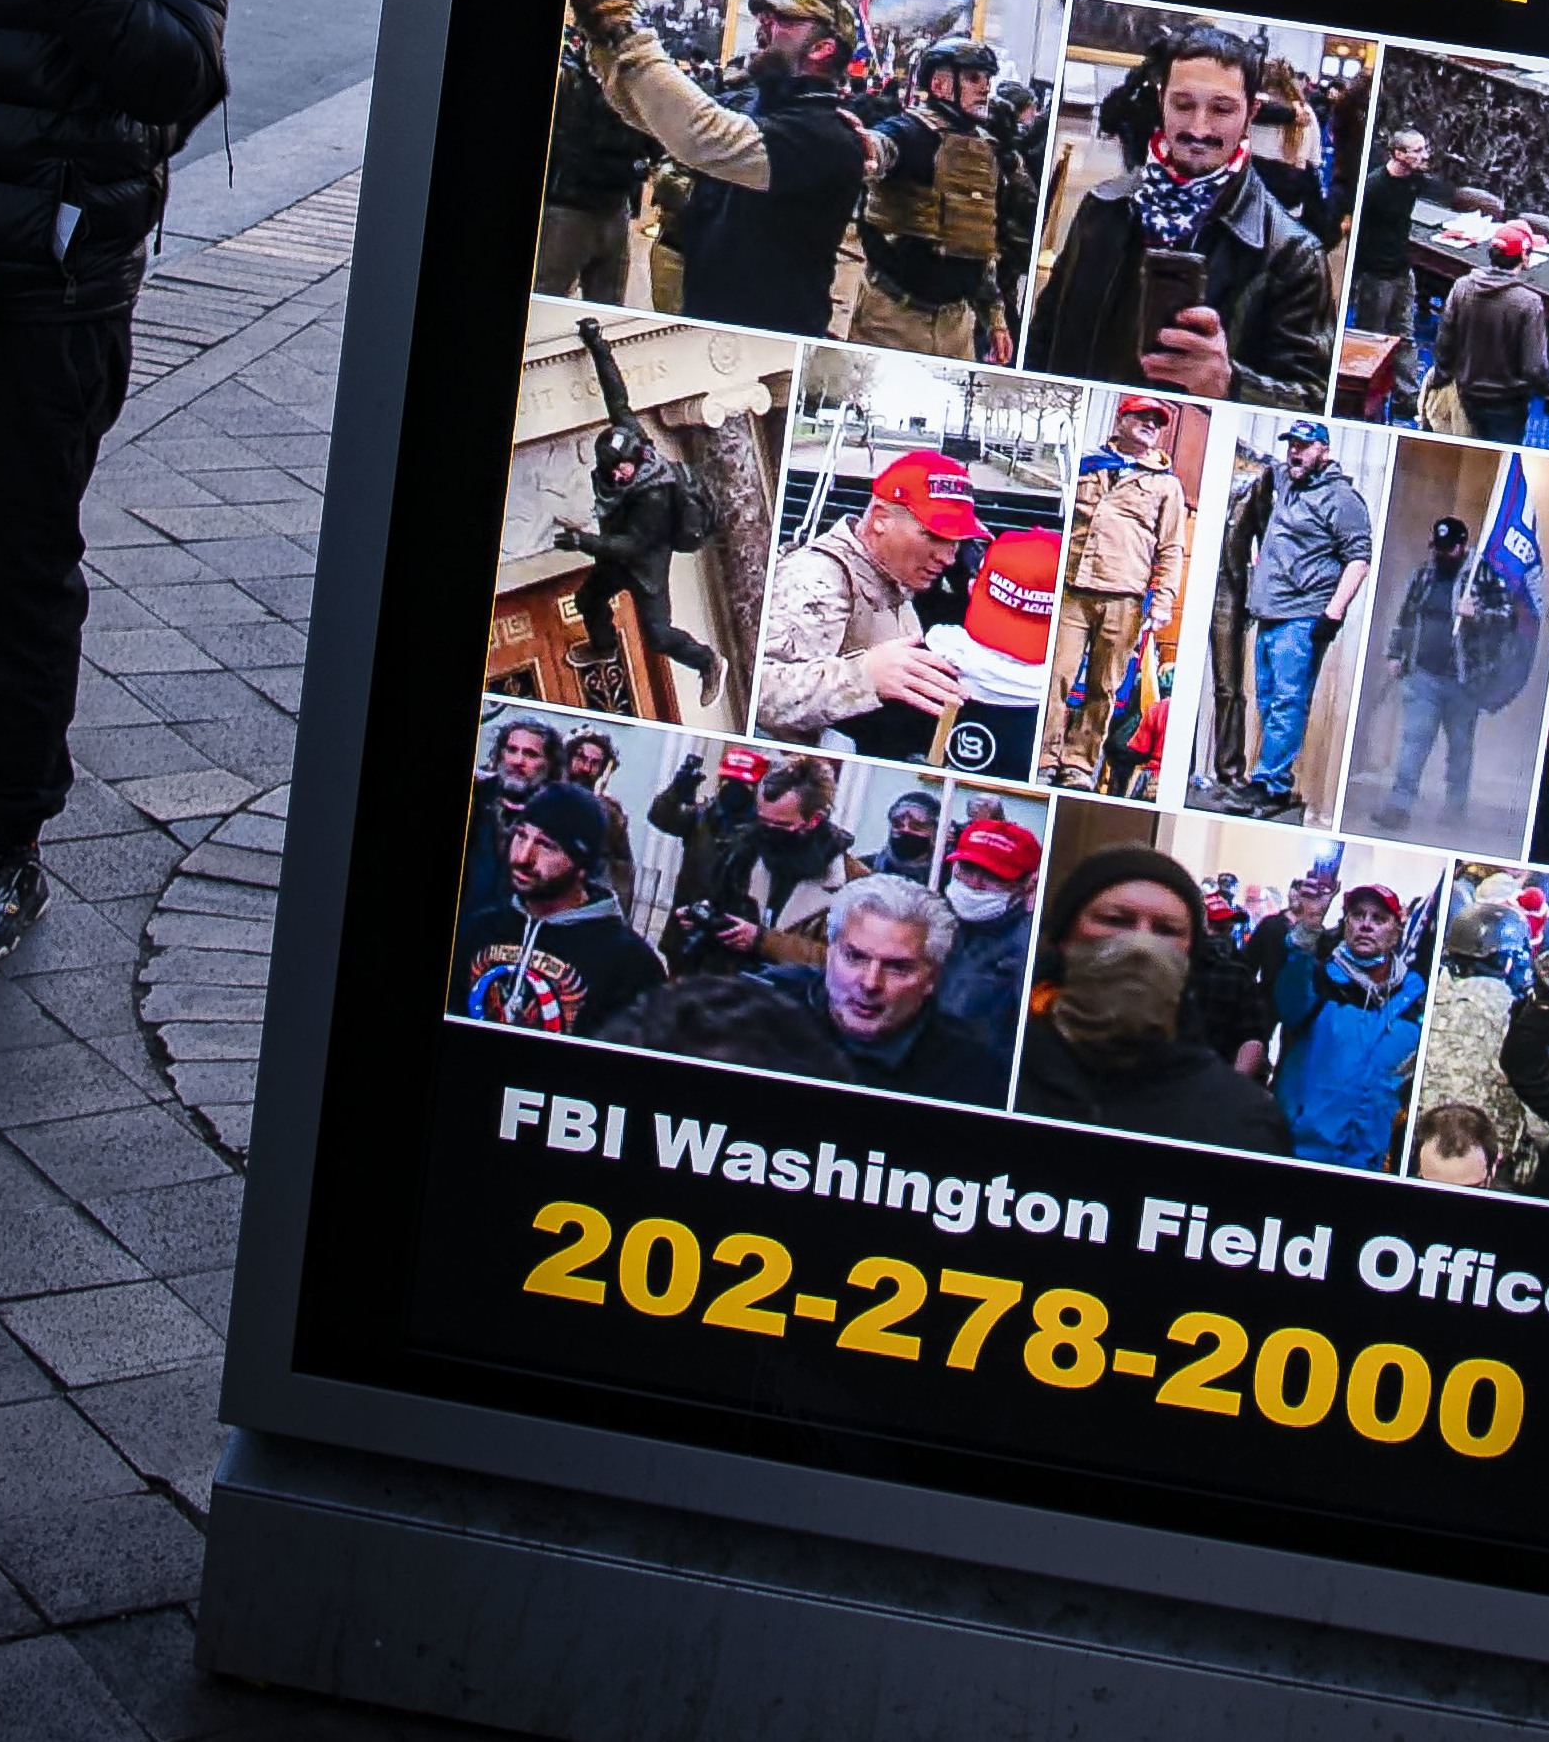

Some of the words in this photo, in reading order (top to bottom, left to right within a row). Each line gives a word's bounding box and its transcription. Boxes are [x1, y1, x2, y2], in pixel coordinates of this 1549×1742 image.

[497, 1086, 627, 1162] FBI
[652, 1110, 1111, 1245] Washington
[1135, 1195, 1333, 1281] Field
[522, 1199, 1526, 1460] 202-278-2000
